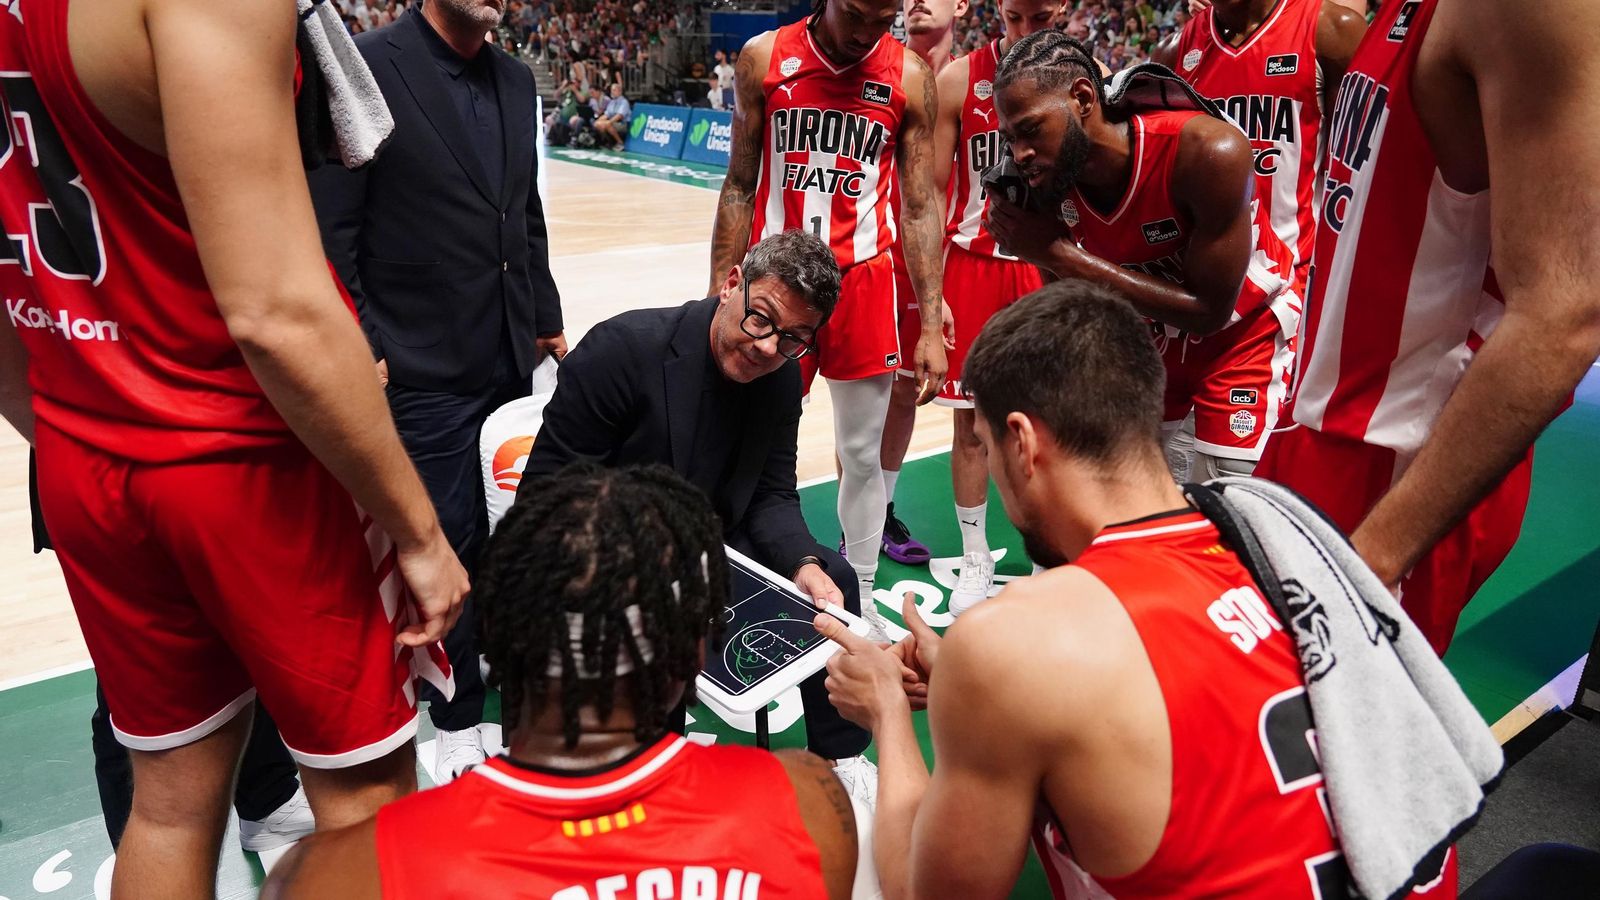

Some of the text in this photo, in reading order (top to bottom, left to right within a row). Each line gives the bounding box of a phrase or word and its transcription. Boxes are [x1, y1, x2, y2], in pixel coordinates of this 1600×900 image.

[864, 94, 888, 103] endesa
[865, 87, 877, 95] liga
[645, 115, 684, 132] Fundación
[1212, 94, 1295, 143] ONA
[643, 129, 670, 147] Unicaja
[773, 107, 885, 166] GIRONA
[782, 162, 867, 198] FIATC
[1146, 229, 1160, 237] liga
[1232, 395, 1251, 403] acb
